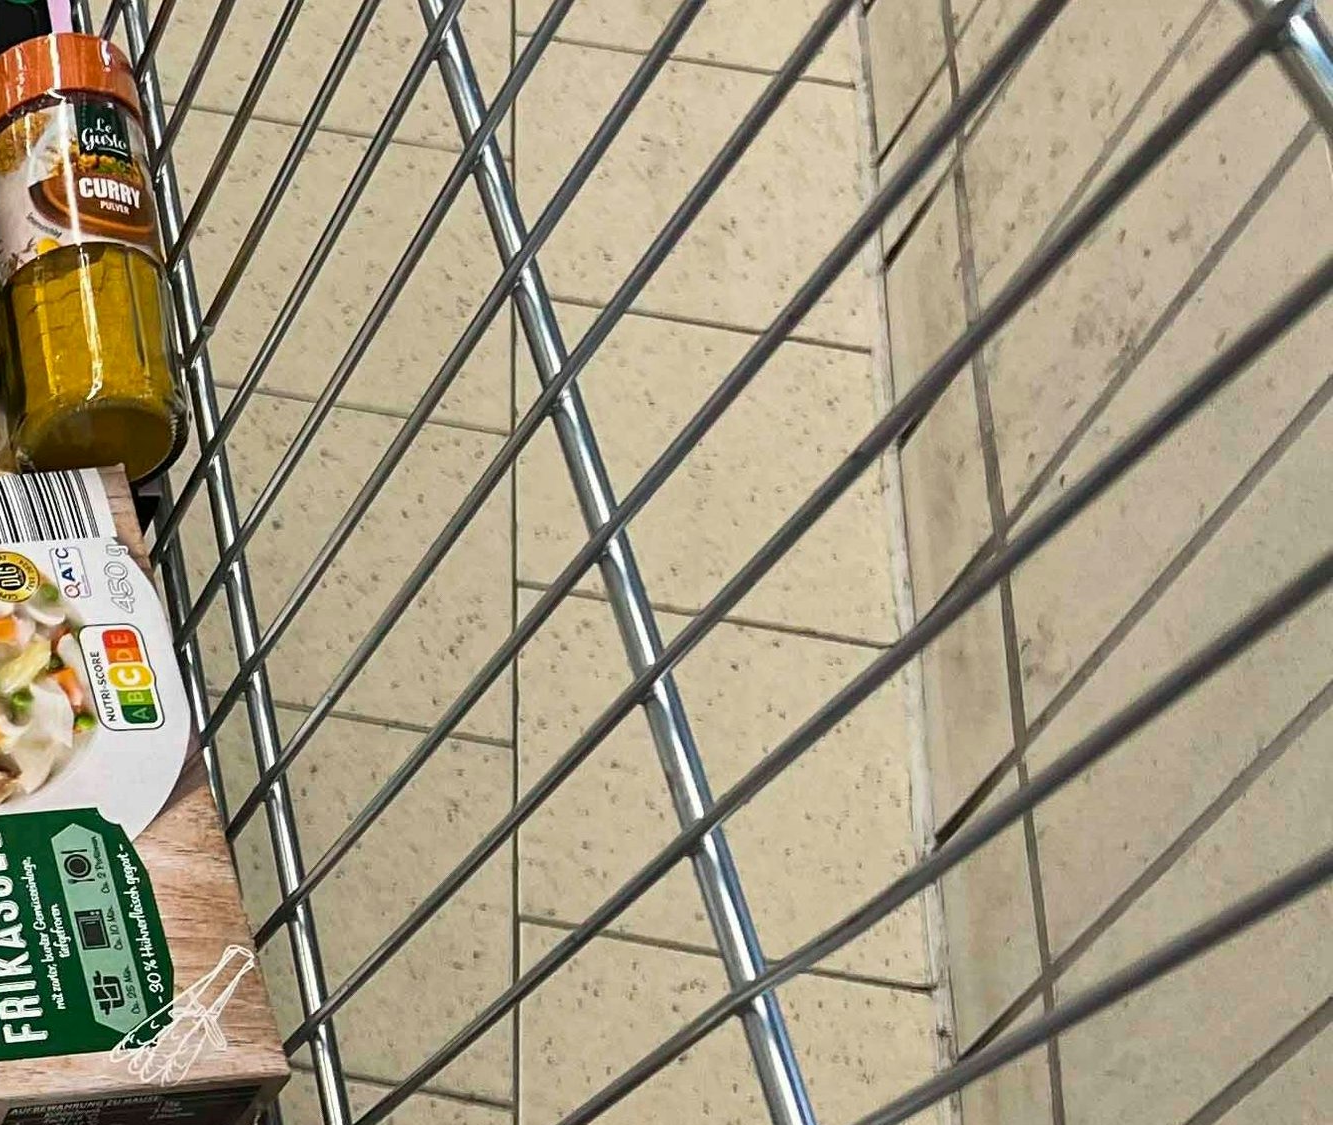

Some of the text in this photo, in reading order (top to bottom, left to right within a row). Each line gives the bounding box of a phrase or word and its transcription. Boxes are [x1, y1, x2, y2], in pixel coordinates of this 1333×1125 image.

[80, 122, 127, 155] Gusto
[94, 116, 112, 134] Le
[78, 176, 139, 208] CURRY
[104, 564, 134, 613] 450
[89, 651, 115, 721] NUTRI-SCORE
[117, 668, 141, 683] C
[50, 904, 70, 959] tiefgefroren
[116, 853, 162, 994] 30 % Hühnerfleisch gegart
[41, 934, 55, 961] bunter
[55, 991, 66, 1010] mit
